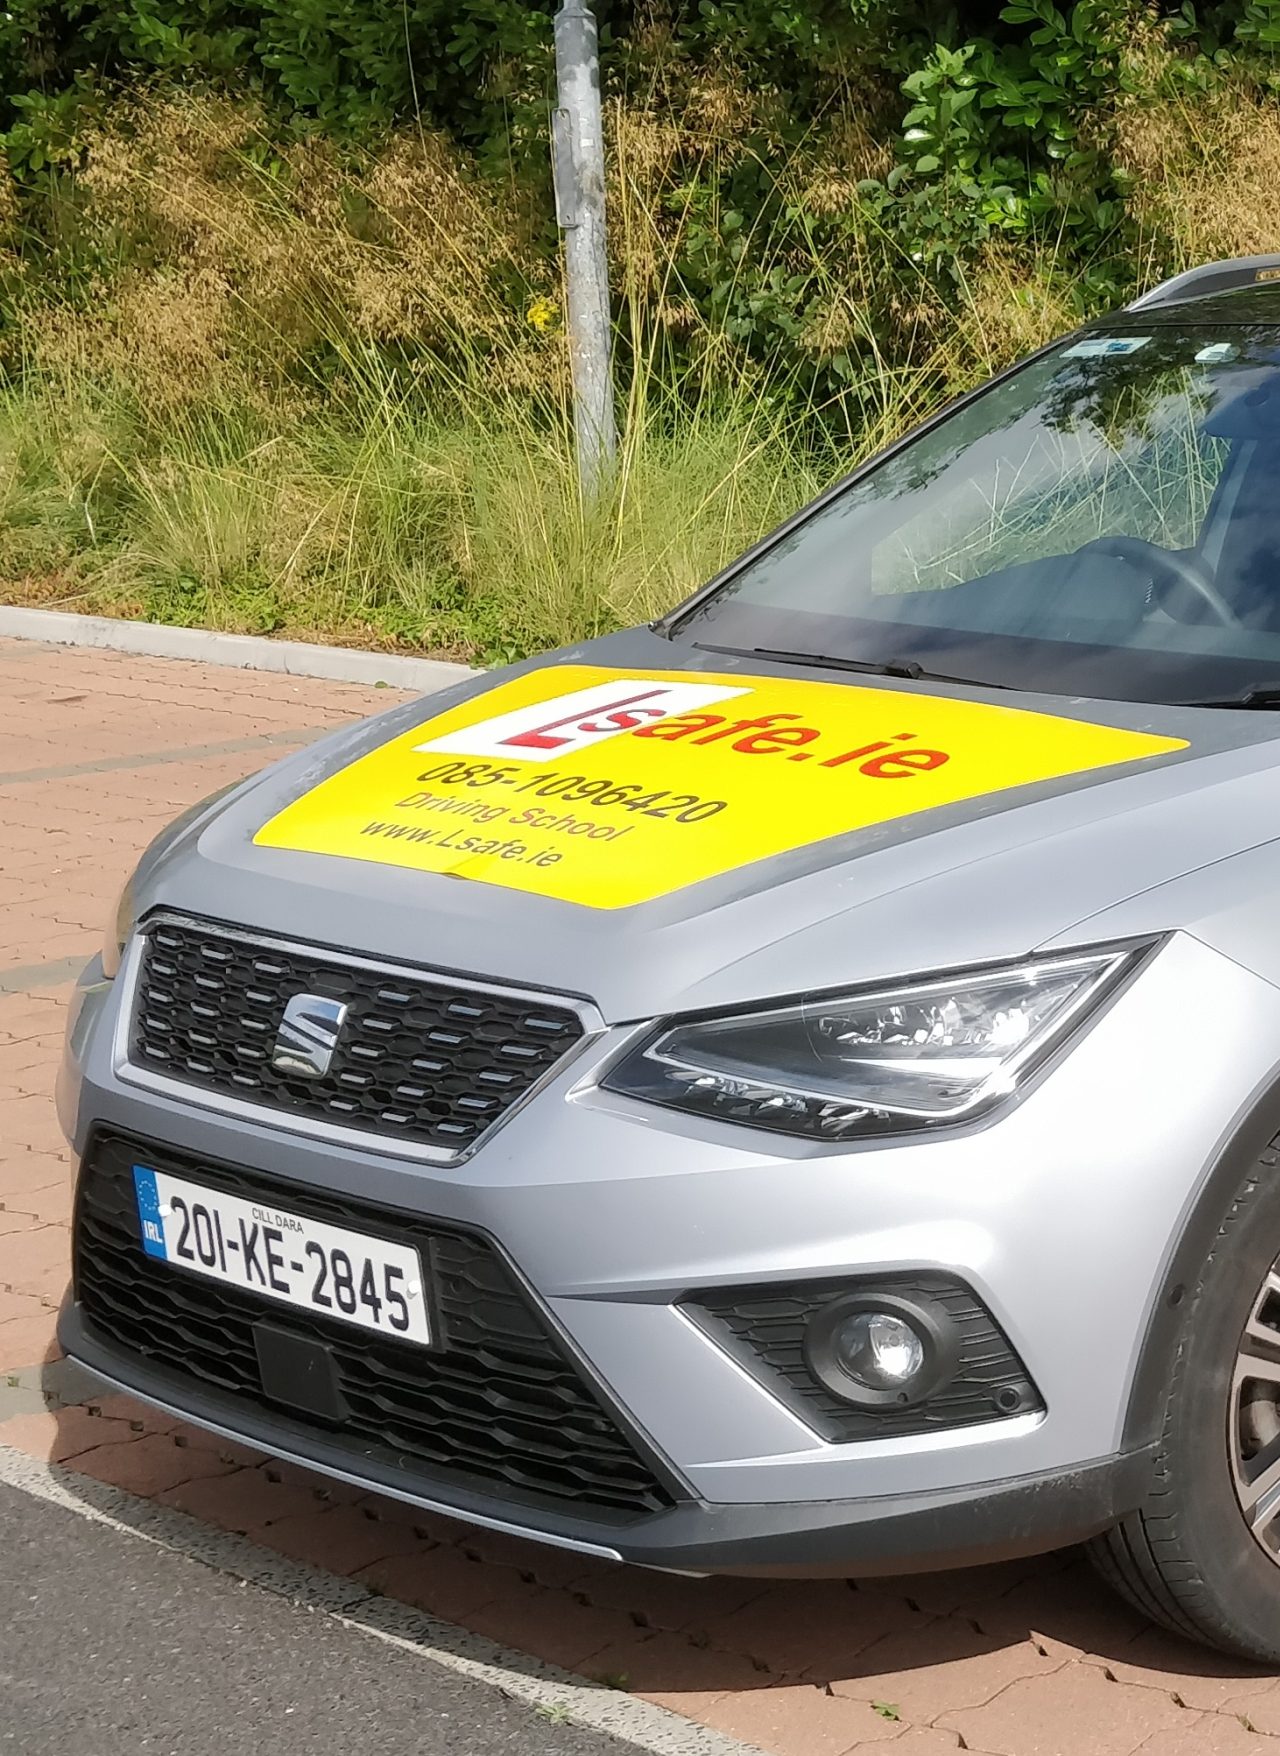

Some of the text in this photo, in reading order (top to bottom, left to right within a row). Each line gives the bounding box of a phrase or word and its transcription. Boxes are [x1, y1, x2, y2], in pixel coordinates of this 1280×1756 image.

[495, 689, 950, 778] Lsafe.ie
[395, 792, 636, 841] Driving School
[416, 761, 728, 823] 085-1096420
[360, 821, 563, 867] www.Lsafe.ie
[143, 1219, 163, 1244] IRL
[252, 1207, 304, 1234] CILL DARA
[170, 1195, 409, 1331] 201-KE-2845
